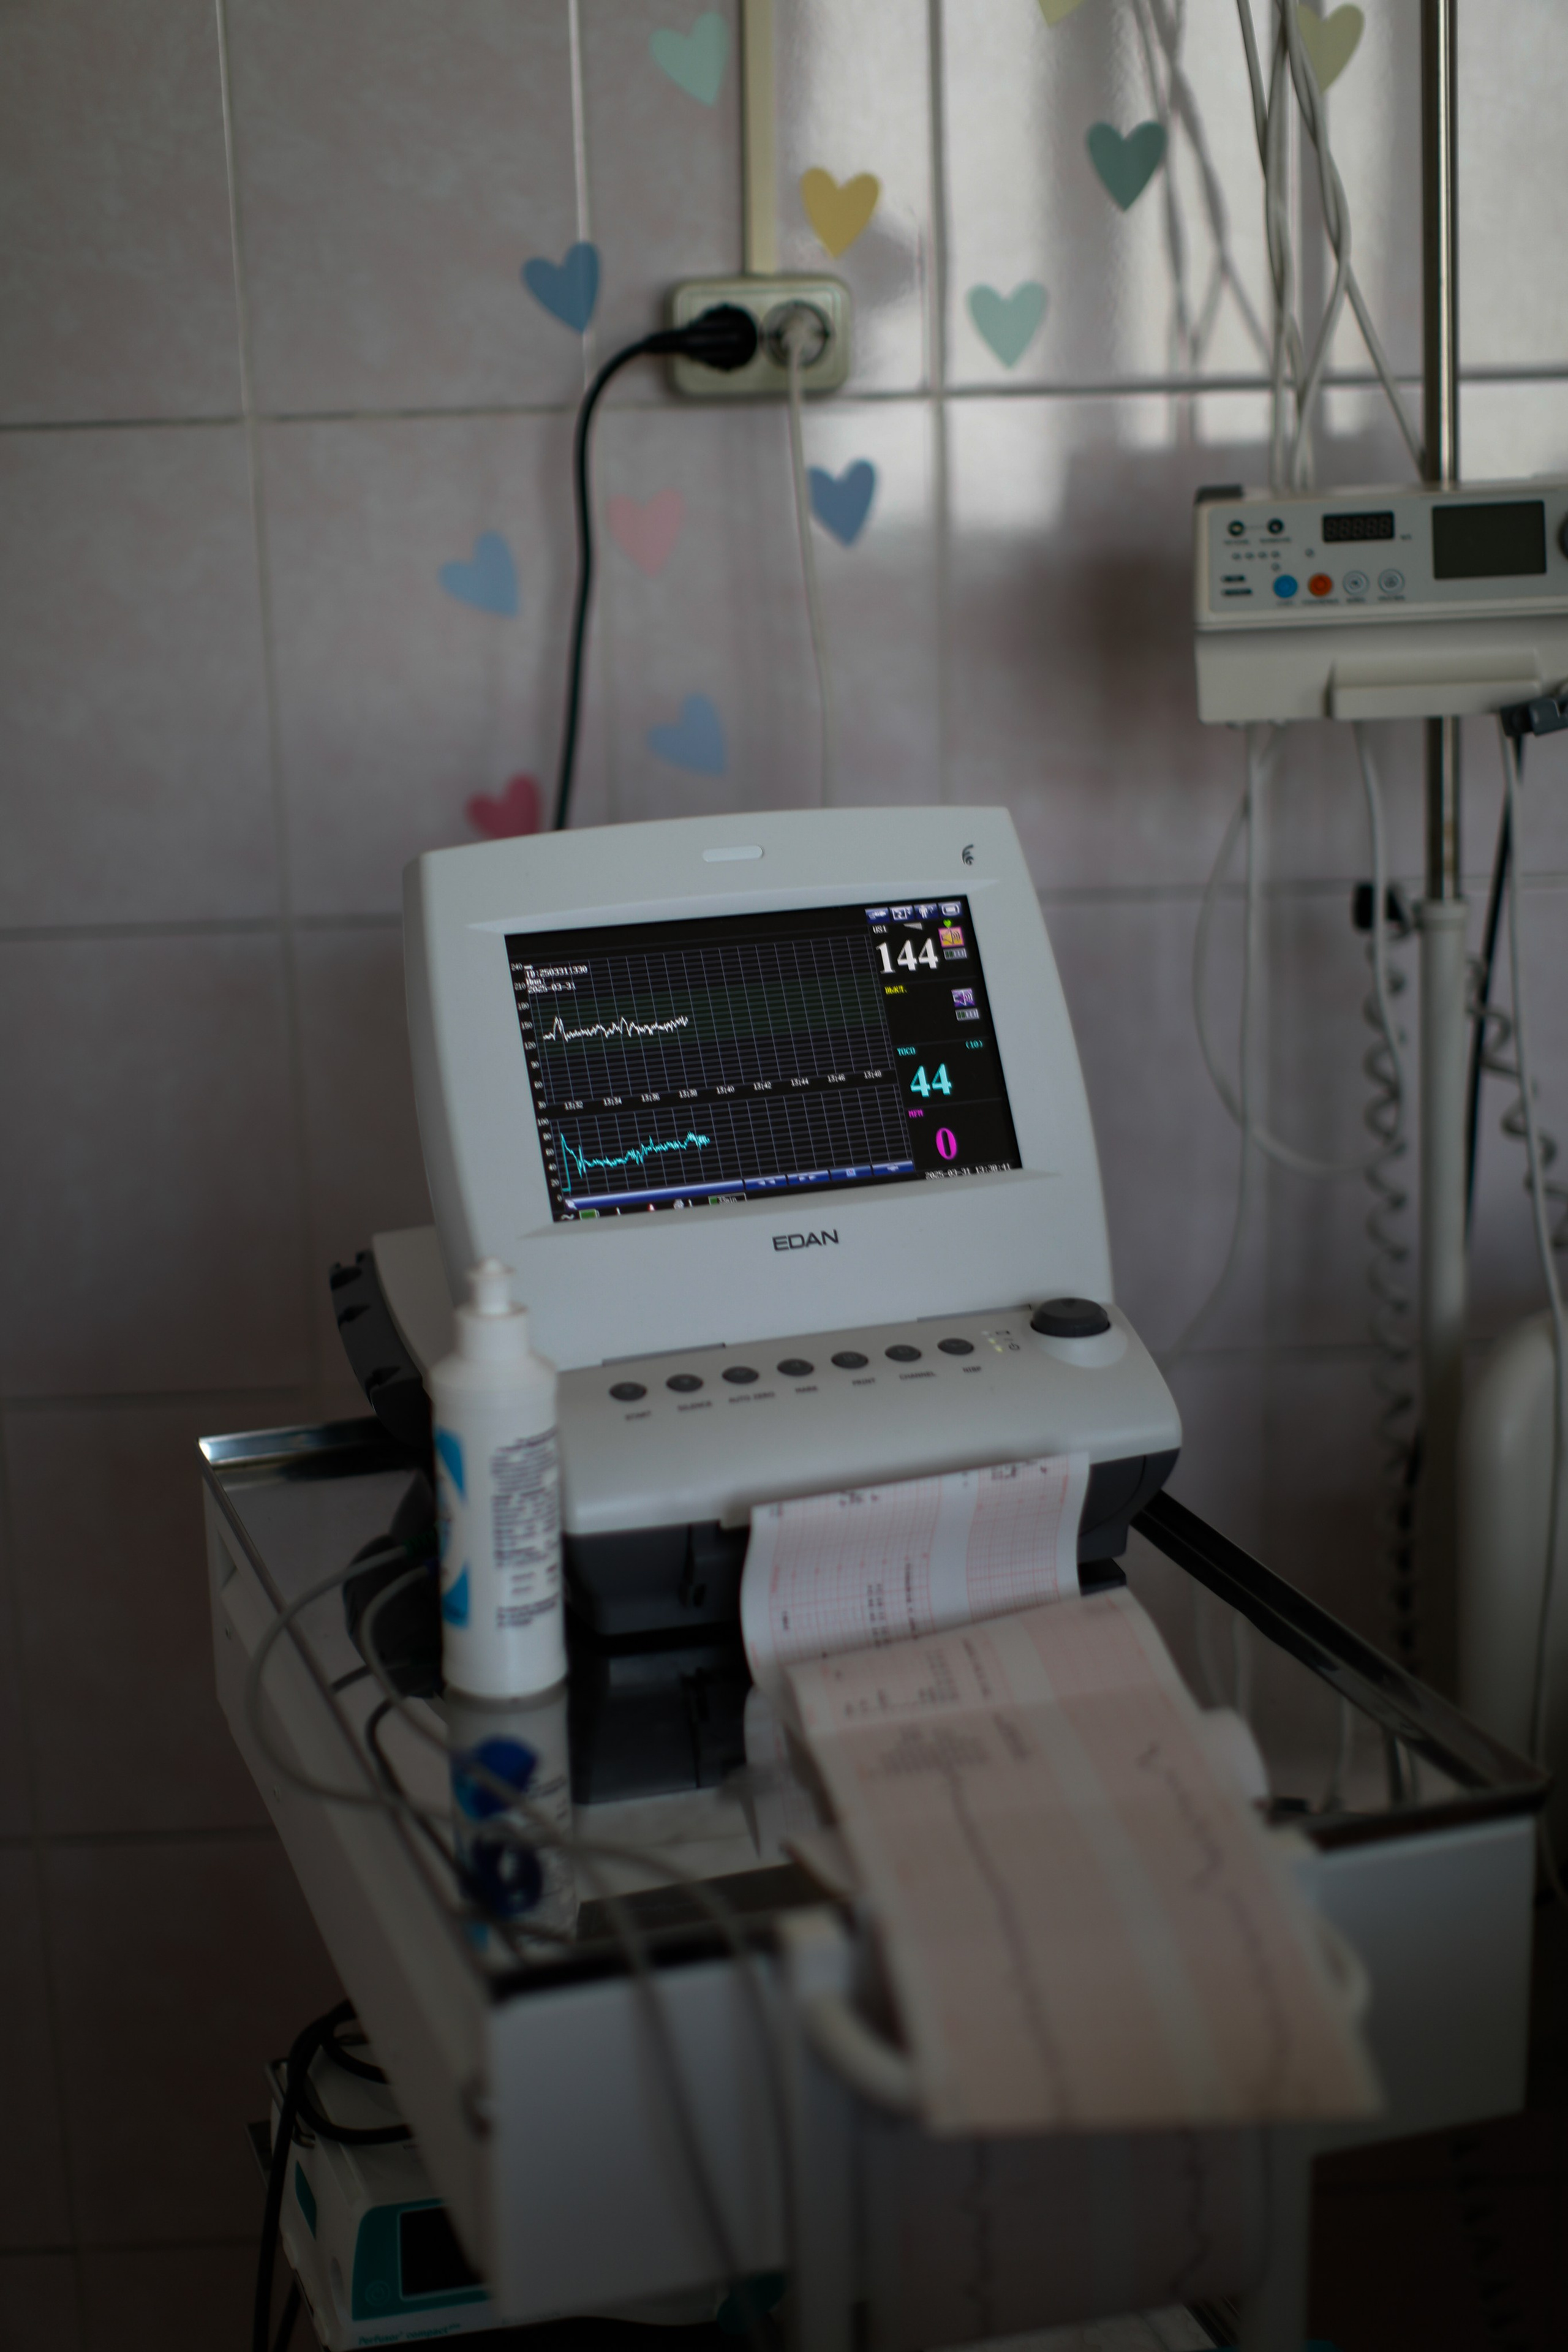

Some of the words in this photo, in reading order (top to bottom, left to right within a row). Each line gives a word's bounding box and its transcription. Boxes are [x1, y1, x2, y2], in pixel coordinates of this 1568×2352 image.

[876, 937, 939, 974] 144
[910, 1063, 952, 1098] 44
[935, 1126, 958, 1161] 0
[772, 1228, 840, 1252] EDAN
